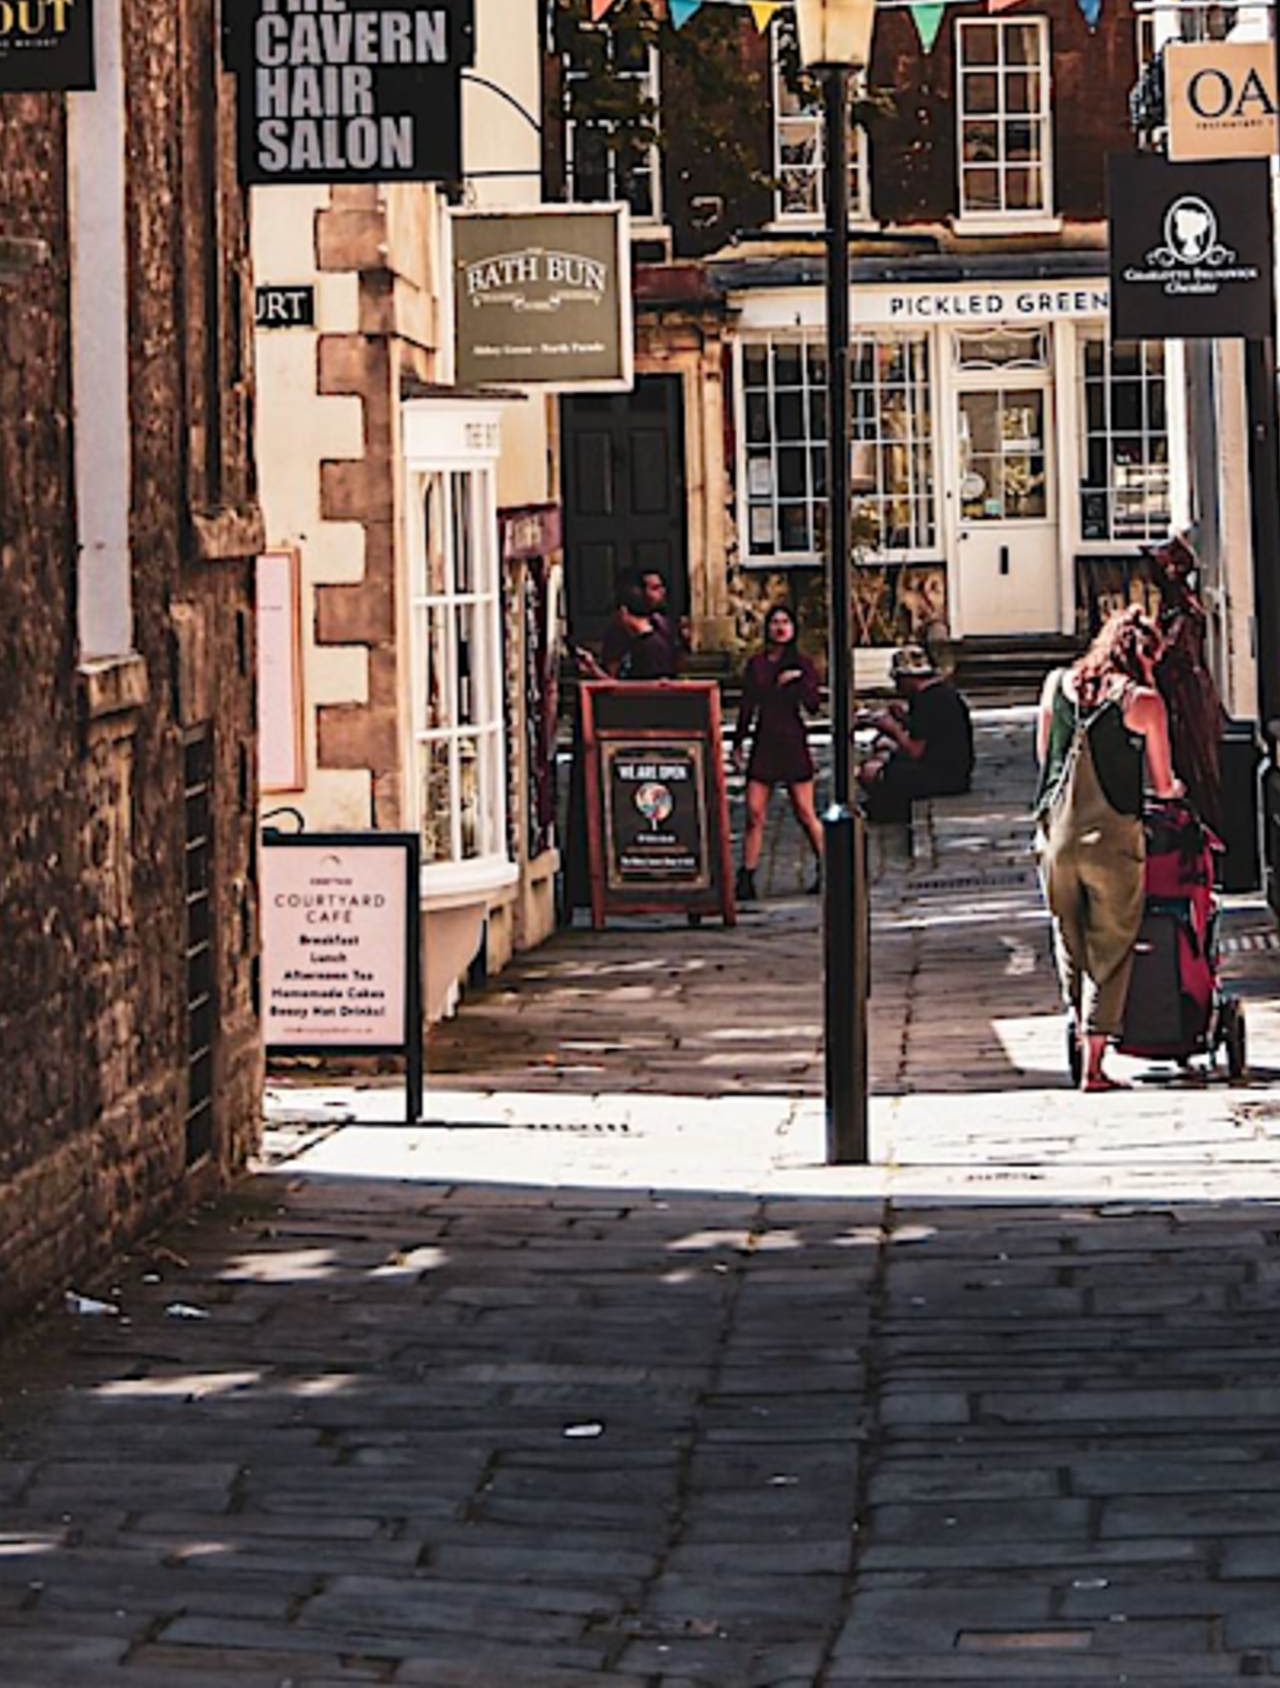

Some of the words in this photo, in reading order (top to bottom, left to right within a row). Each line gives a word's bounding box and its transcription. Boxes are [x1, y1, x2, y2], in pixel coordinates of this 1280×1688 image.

[255, 10, 448, 67] CAVERN
[256, 65, 375, 118] HAIR
[257, 116, 414, 173] SALON
[466, 256, 539, 296] BATH
[546, 256, 607, 294] BUN
[890, 294, 1004, 315] PICKLED
[1016, 290, 1110, 313] GREEN
[273, 893, 386, 909] COURTYARD
[299, 934, 359, 947] Breakfast
[310, 950, 347, 963] Lunch
[271, 987, 343, 999] Homemade
